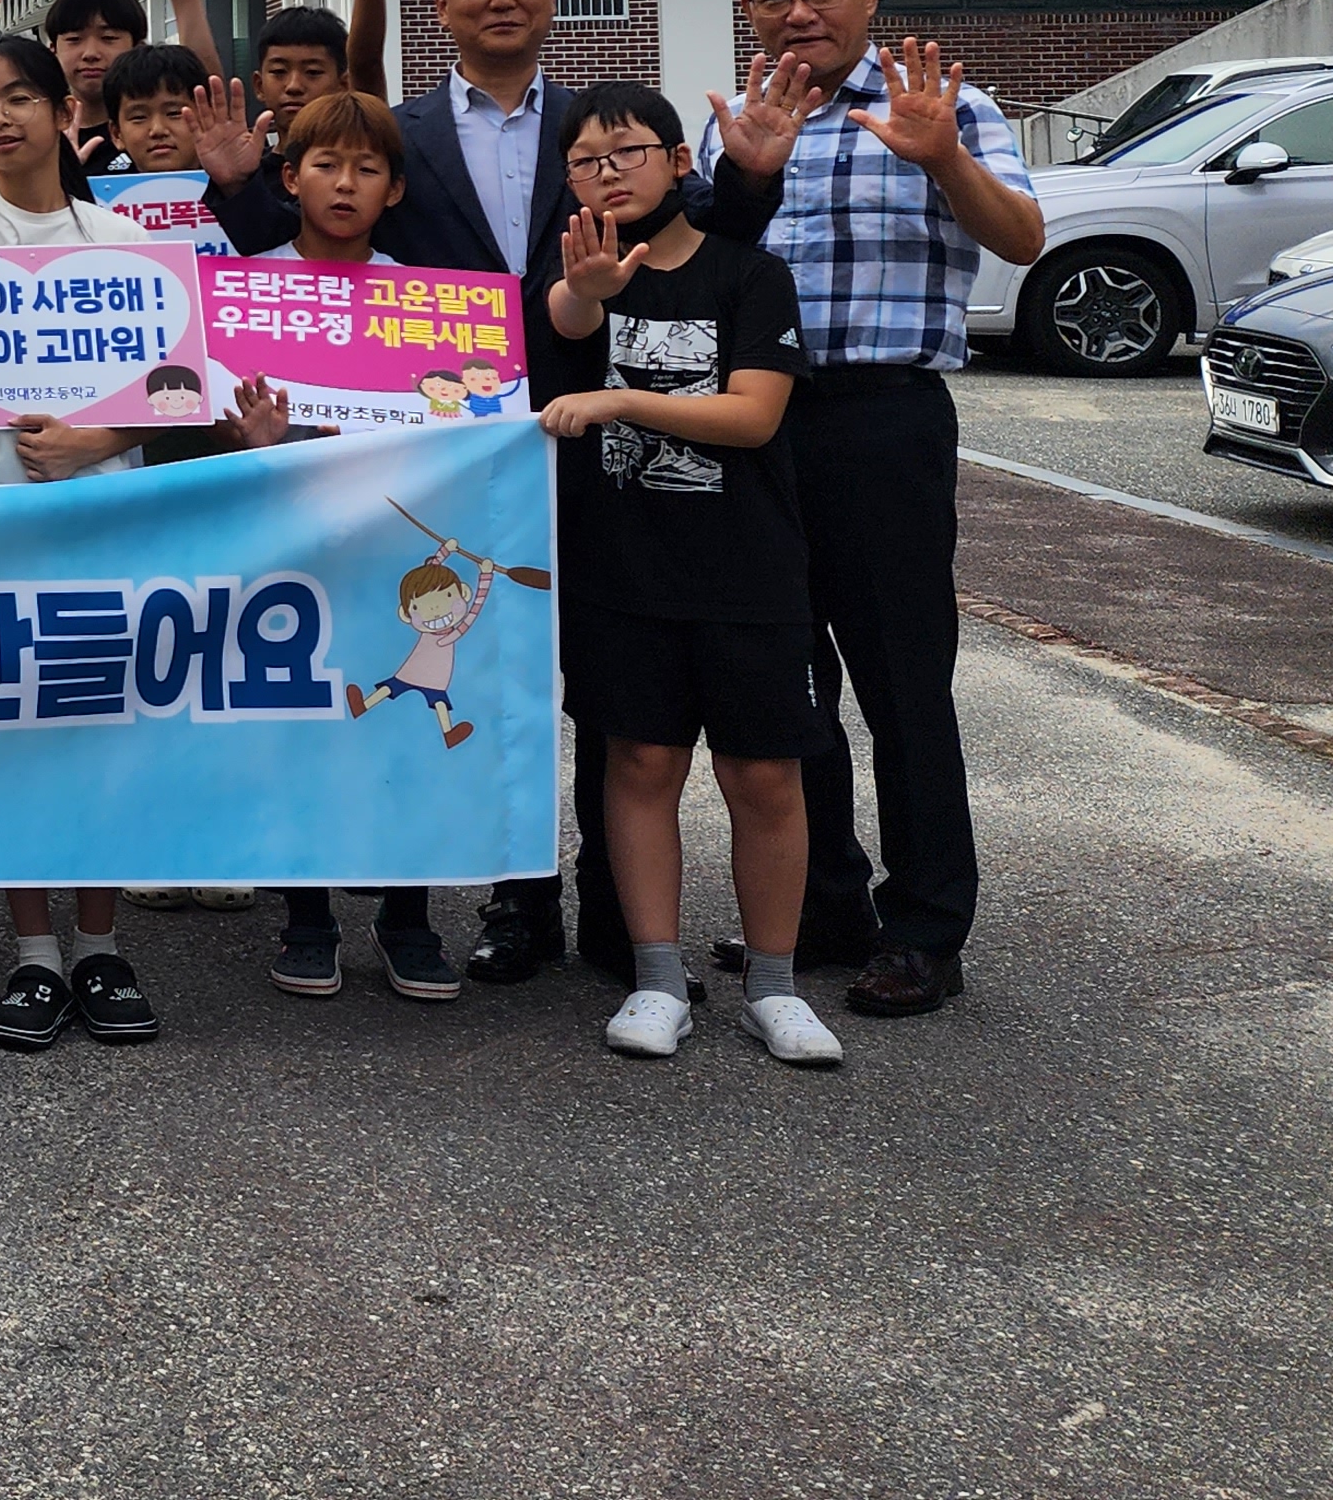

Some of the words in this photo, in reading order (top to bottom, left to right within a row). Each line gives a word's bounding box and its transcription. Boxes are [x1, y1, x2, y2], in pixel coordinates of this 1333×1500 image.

[212, 270, 355, 307] 도란도란
[364, 278, 506, 319] 고운말에
[212, 306, 353, 346] 우리우정
[364, 314, 510, 357] 새록새록
[1242, 399, 1271, 426] 1780
